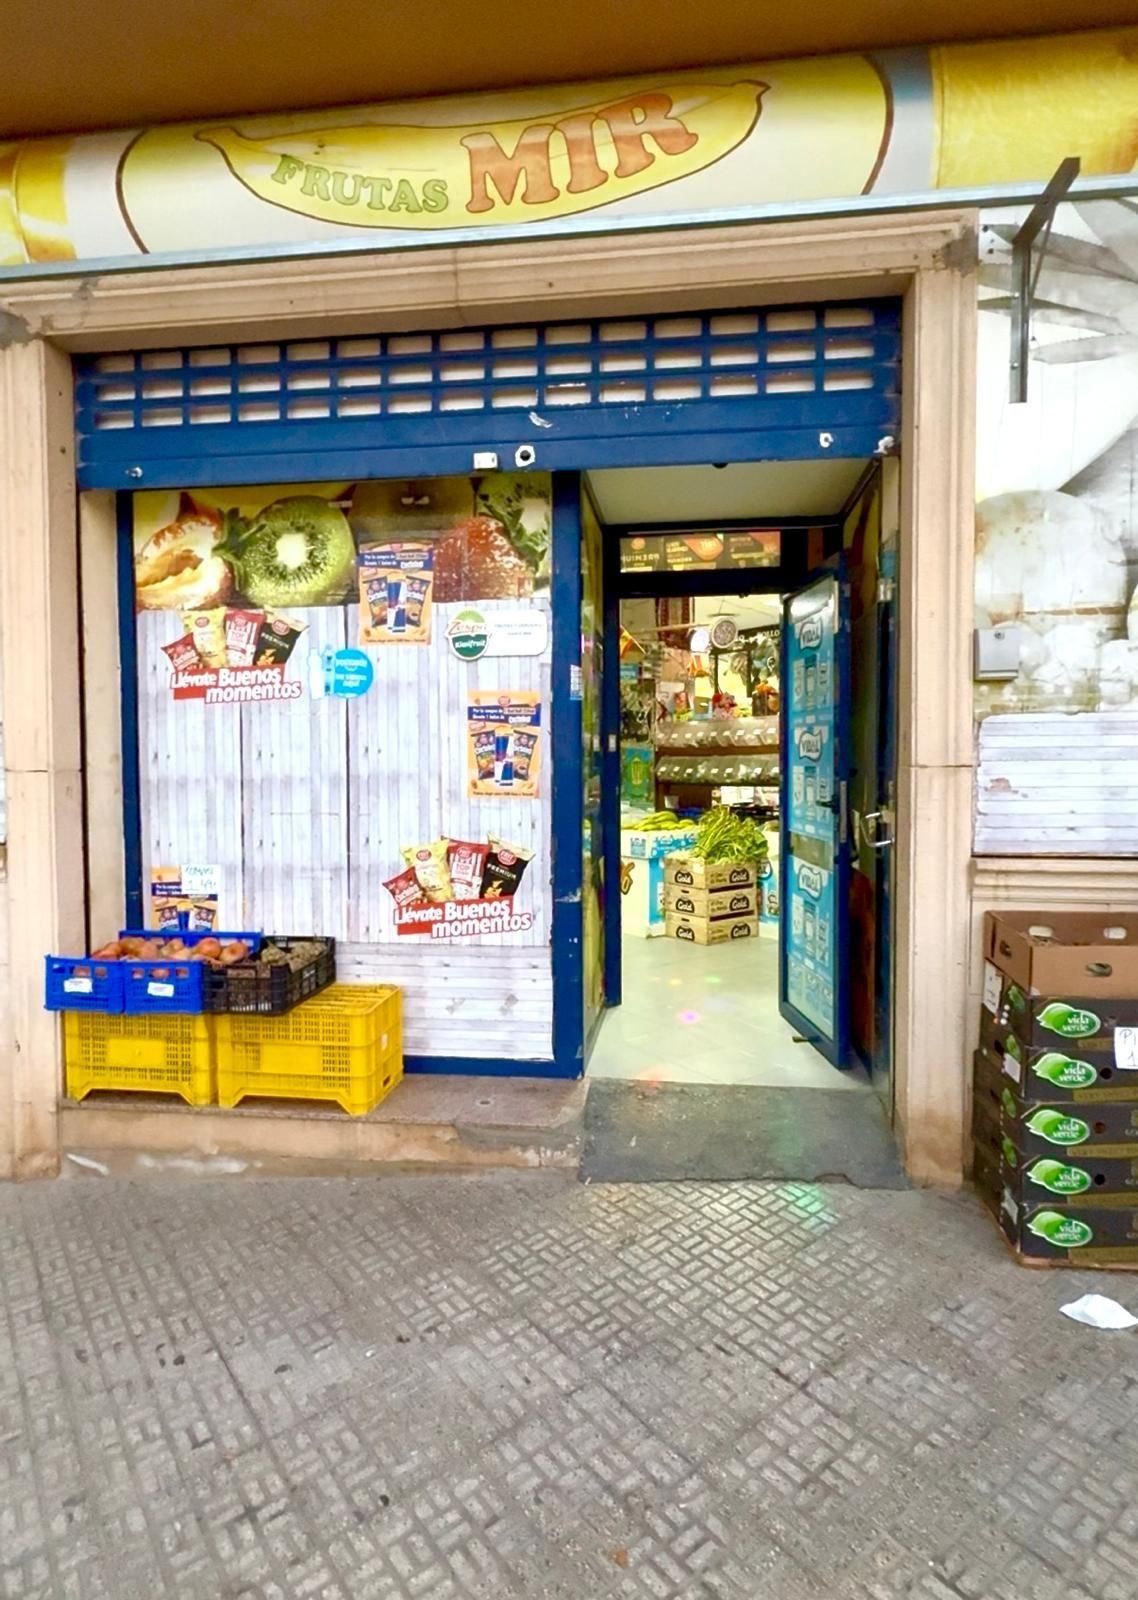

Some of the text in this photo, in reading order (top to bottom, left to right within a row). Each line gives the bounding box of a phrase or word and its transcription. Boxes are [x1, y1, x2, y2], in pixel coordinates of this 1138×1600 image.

[272, 93, 699, 214] FRUTAS MIR
[218, 668, 282, 687] Buenos
[205, 682, 302, 704] momentos
[486, 864, 516, 880] PREMIUM
[730, 871, 748, 882] Gold
[676, 874, 692, 884] Gold
[444, 900, 510, 920] Buenos
[677, 902, 694, 912] Gold
[730, 899, 748, 910] Gold
[432, 913, 532, 938] momentos
[677, 929, 694, 940] Gold
[732, 926, 749, 938] Gold
[1067, 1012, 1089, 1024] vida
[1062, 1024, 1088, 1032] verde
[1063, 1062, 1086, 1074] vida
[1059, 1074, 1086, 1082] verde
[1057, 1119, 1079, 1131] vida
[1053, 1130, 1079, 1138] verde
[1059, 1169, 1081, 1180] vida
[1054, 1180, 1080, 1188] verde
[1060, 1221, 1082, 1233] vida
[1055, 1232, 1081, 1240] verde
